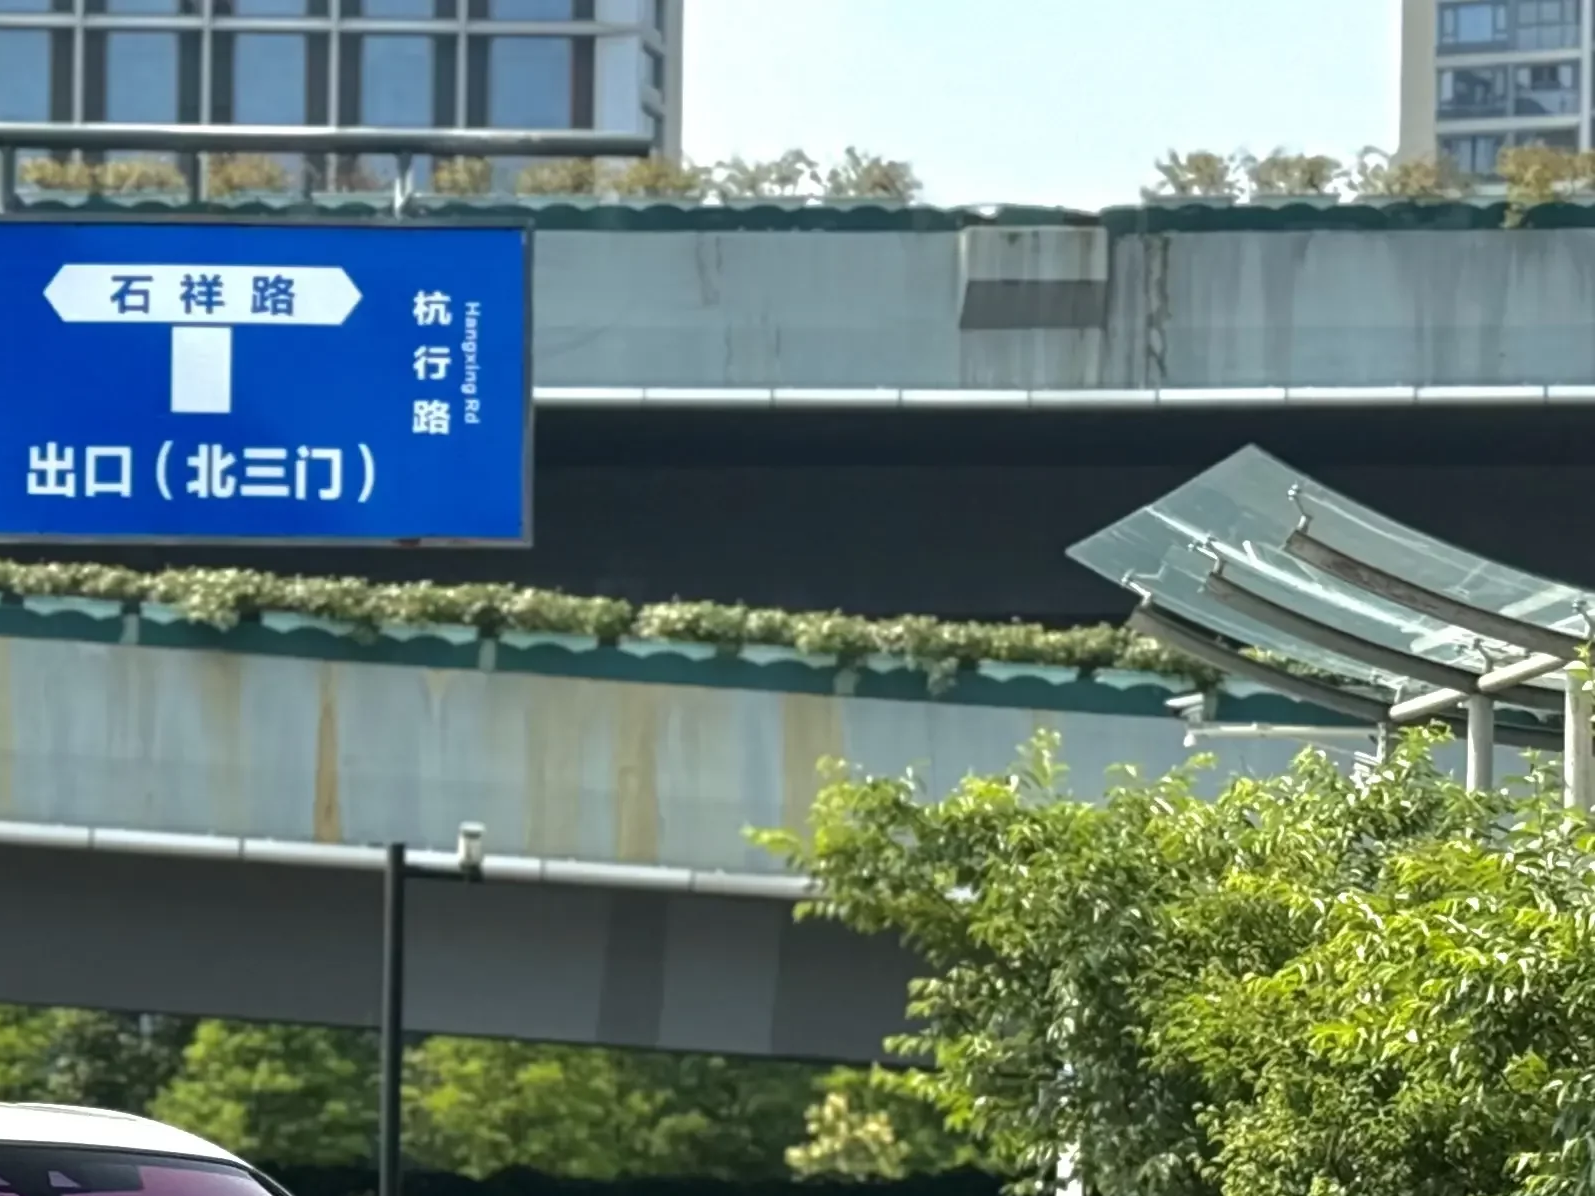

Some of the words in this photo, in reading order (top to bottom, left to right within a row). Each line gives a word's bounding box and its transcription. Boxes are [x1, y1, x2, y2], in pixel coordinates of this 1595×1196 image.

[109, 273, 295, 316] 石祥路
[412, 289, 453, 435] 杭行路
[460, 301, 481, 395] Hangxing
[463, 397, 481, 424] Rd
